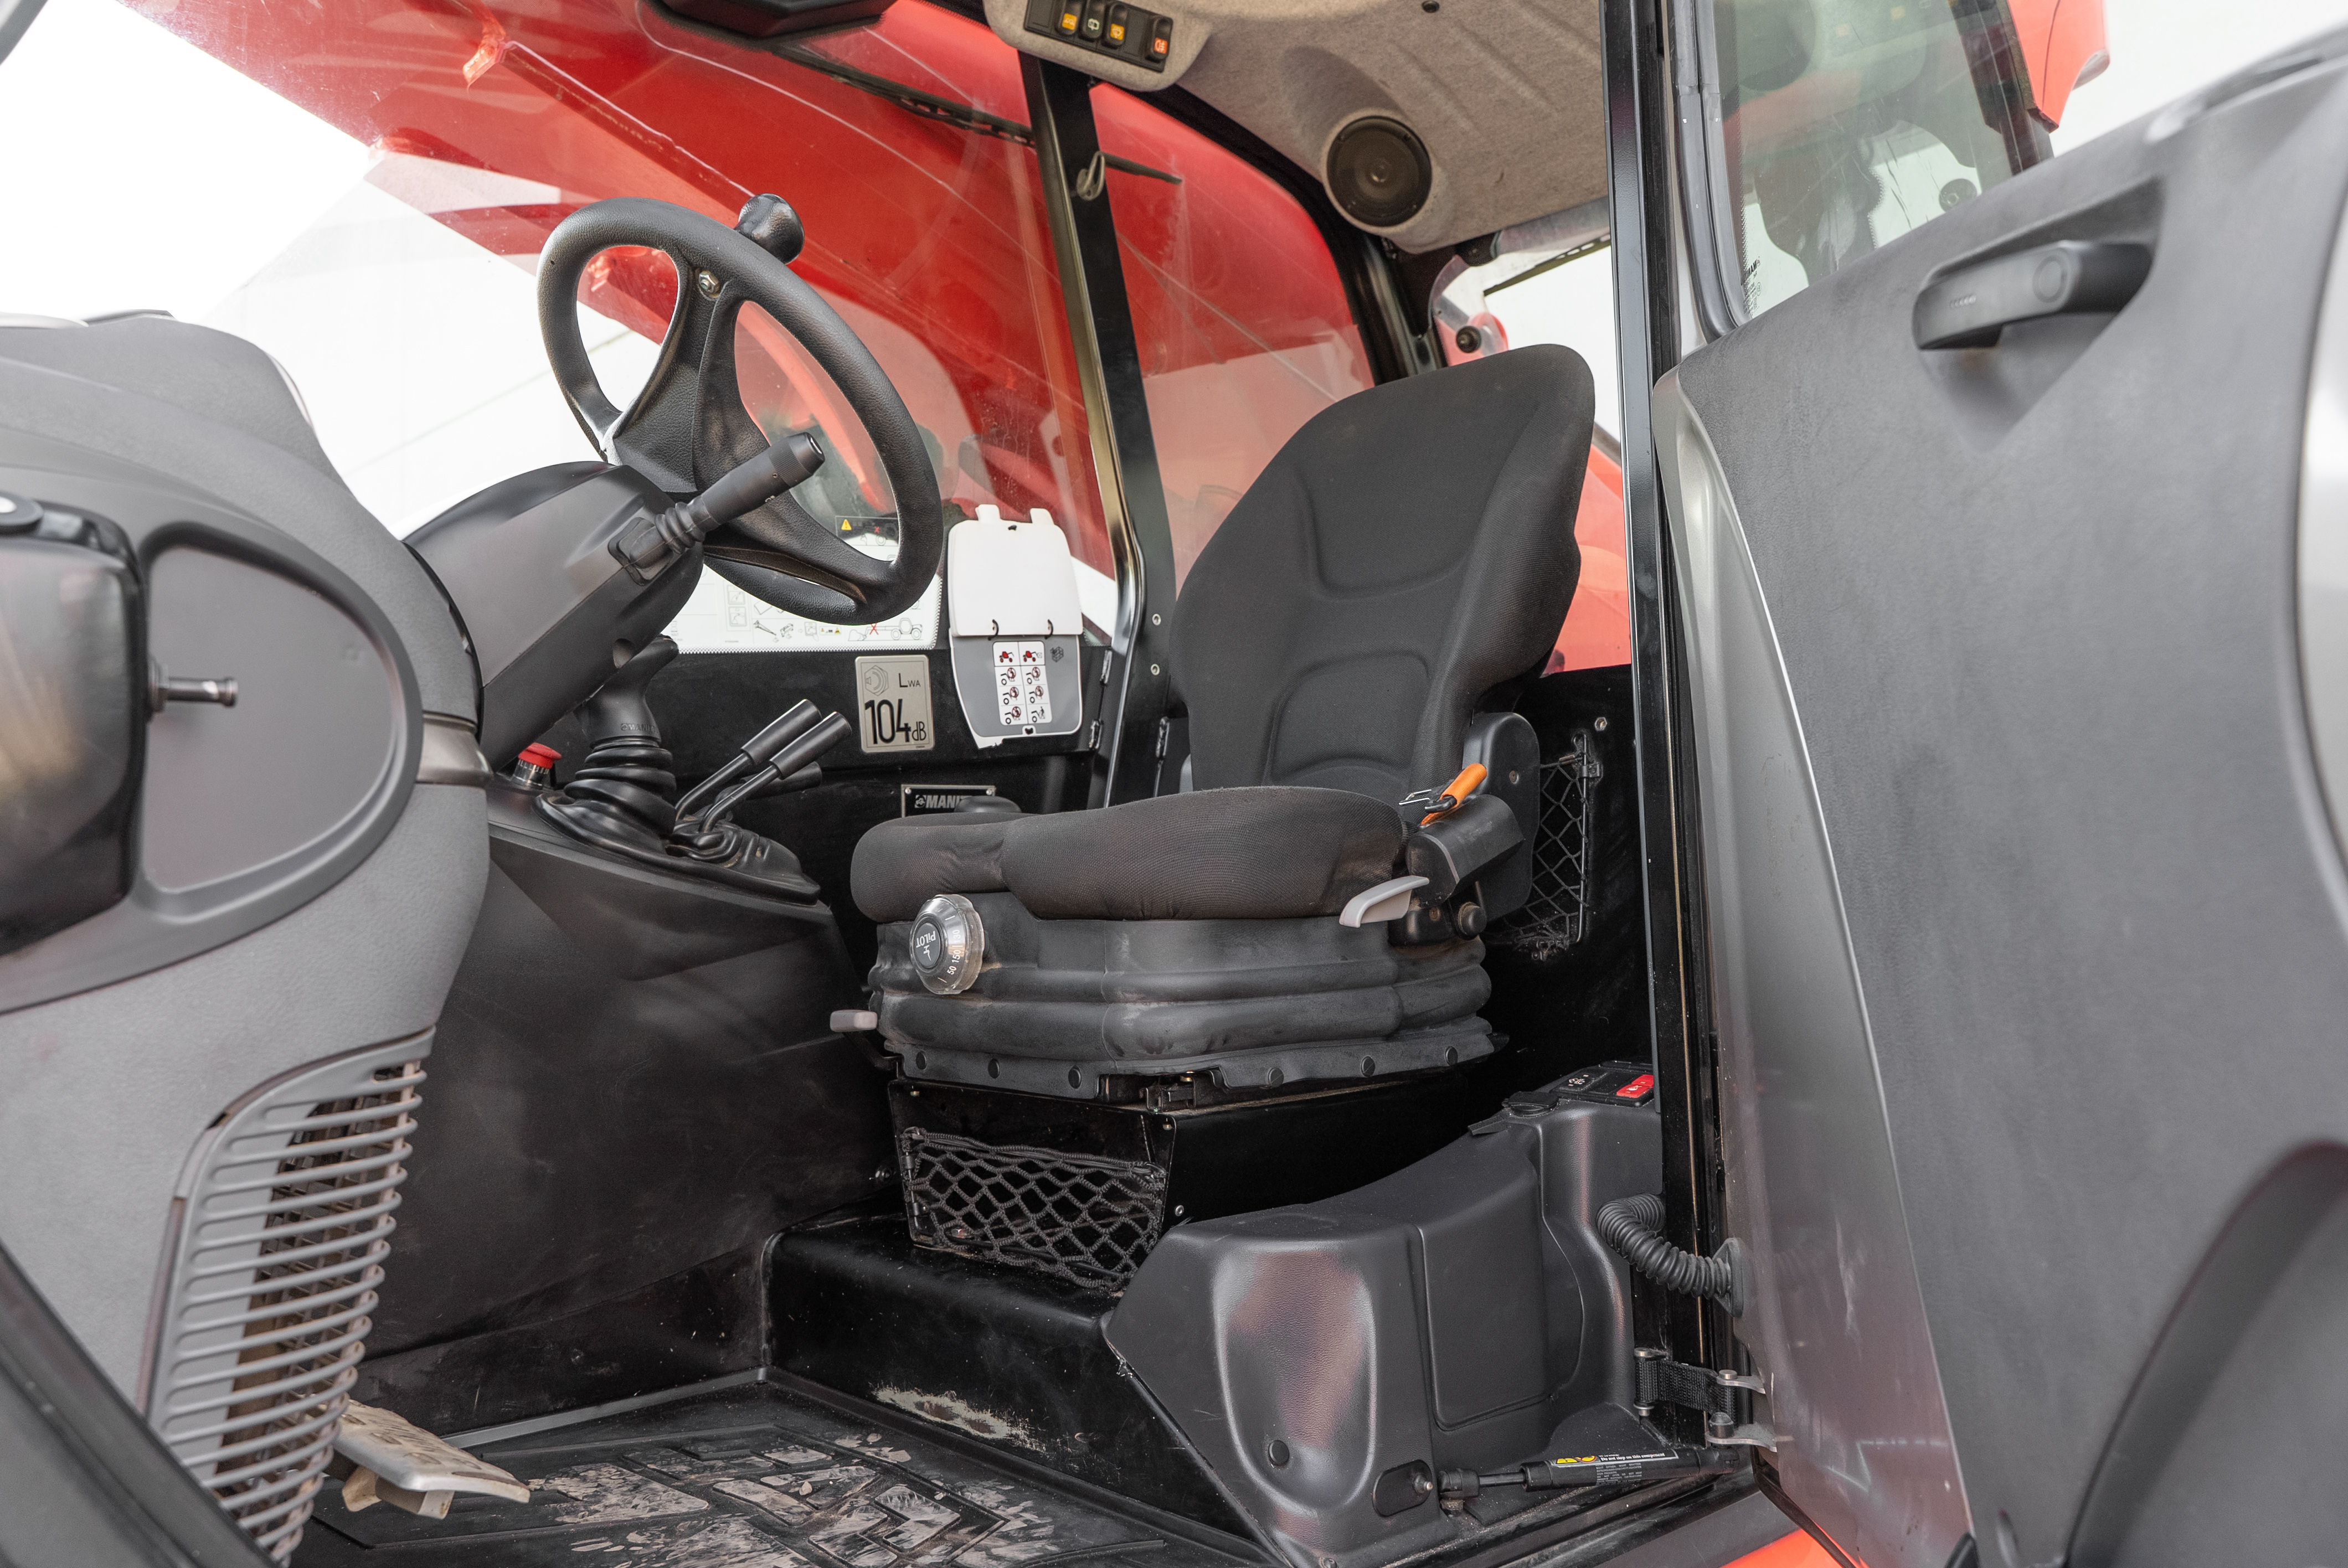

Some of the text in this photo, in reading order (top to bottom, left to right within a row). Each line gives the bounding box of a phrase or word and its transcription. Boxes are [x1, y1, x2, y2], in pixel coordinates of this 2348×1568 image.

[864, 699, 912, 745] 104
[925, 795, 972, 808] MANI
[951, 950, 961, 963] 150
[947, 966, 957, 975] 50
